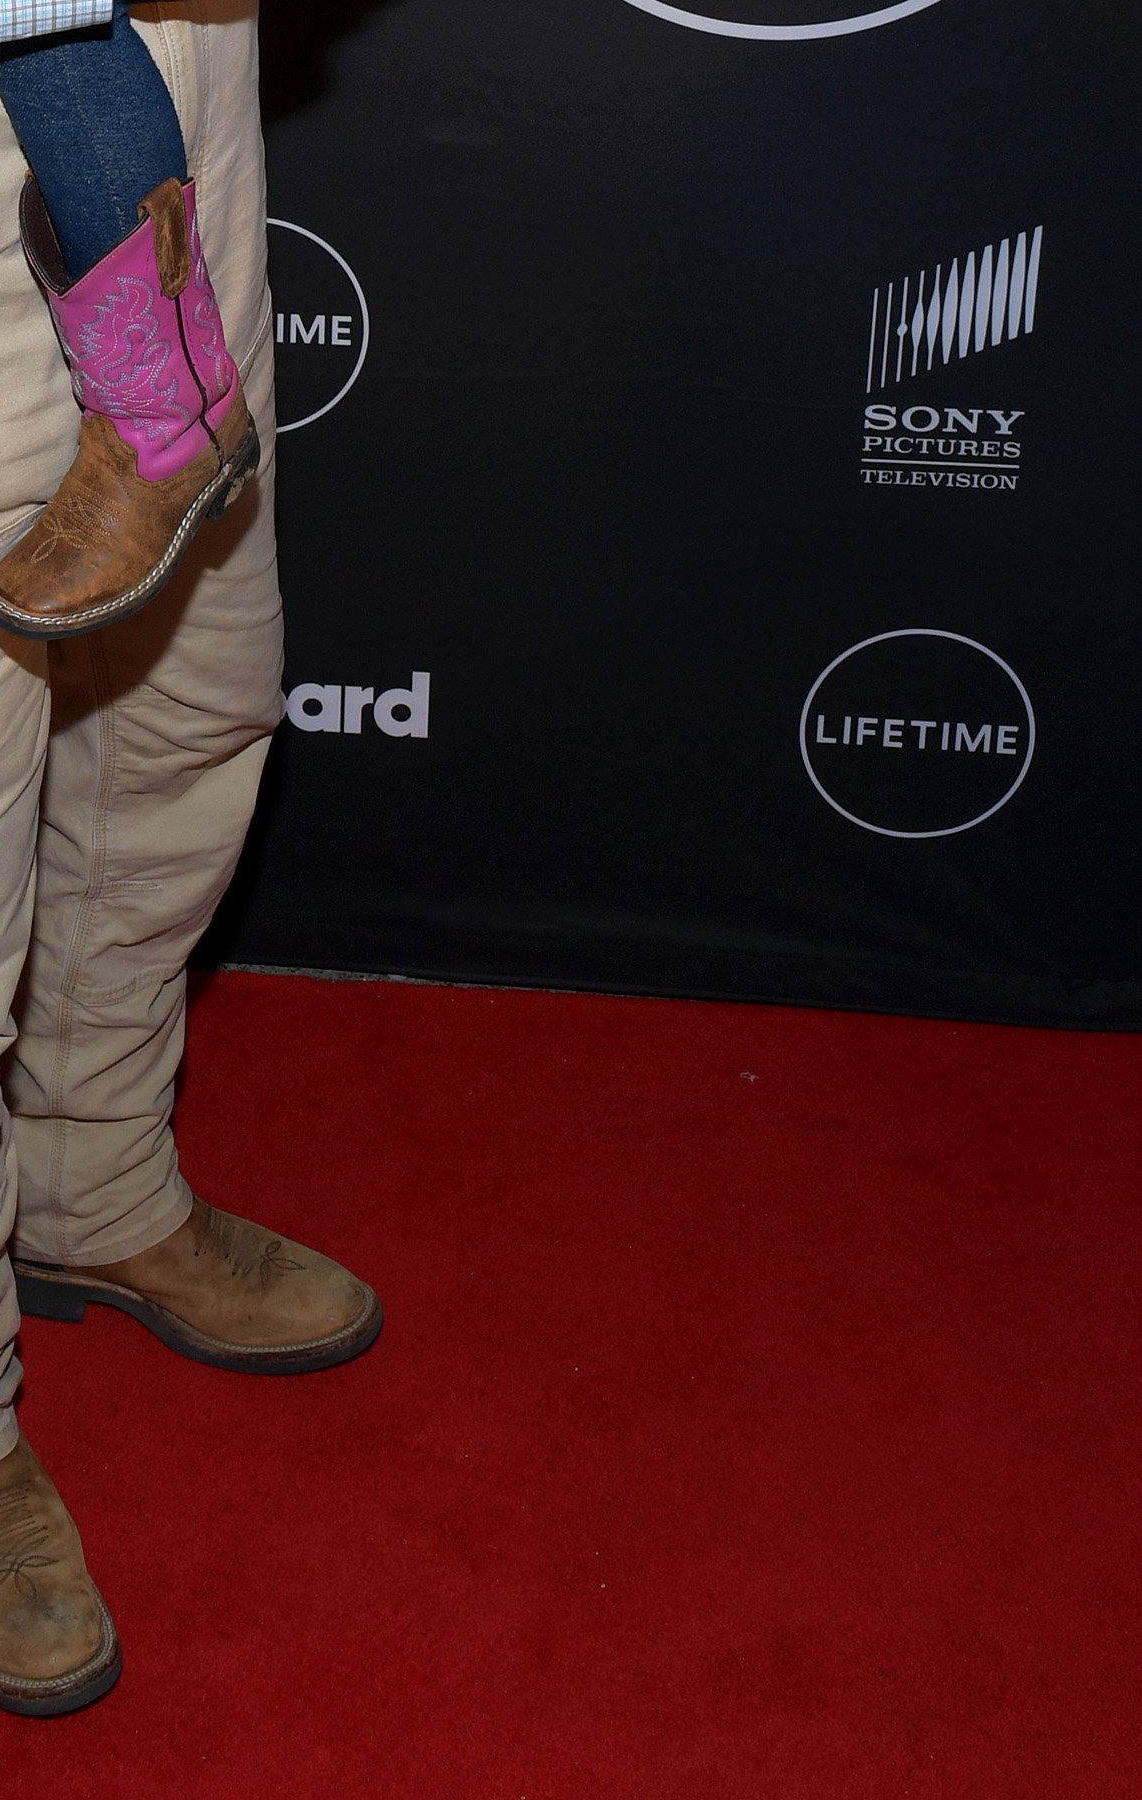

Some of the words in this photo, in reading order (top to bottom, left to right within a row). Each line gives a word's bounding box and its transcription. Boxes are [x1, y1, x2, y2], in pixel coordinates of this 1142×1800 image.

[276, 313, 352, 346] IME
[864, 404, 1026, 435] SONY
[861, 436, 1022, 459] PICTURES
[860, 469, 1019, 491] TELEVISION
[816, 713, 1019, 756] LIFETIME
